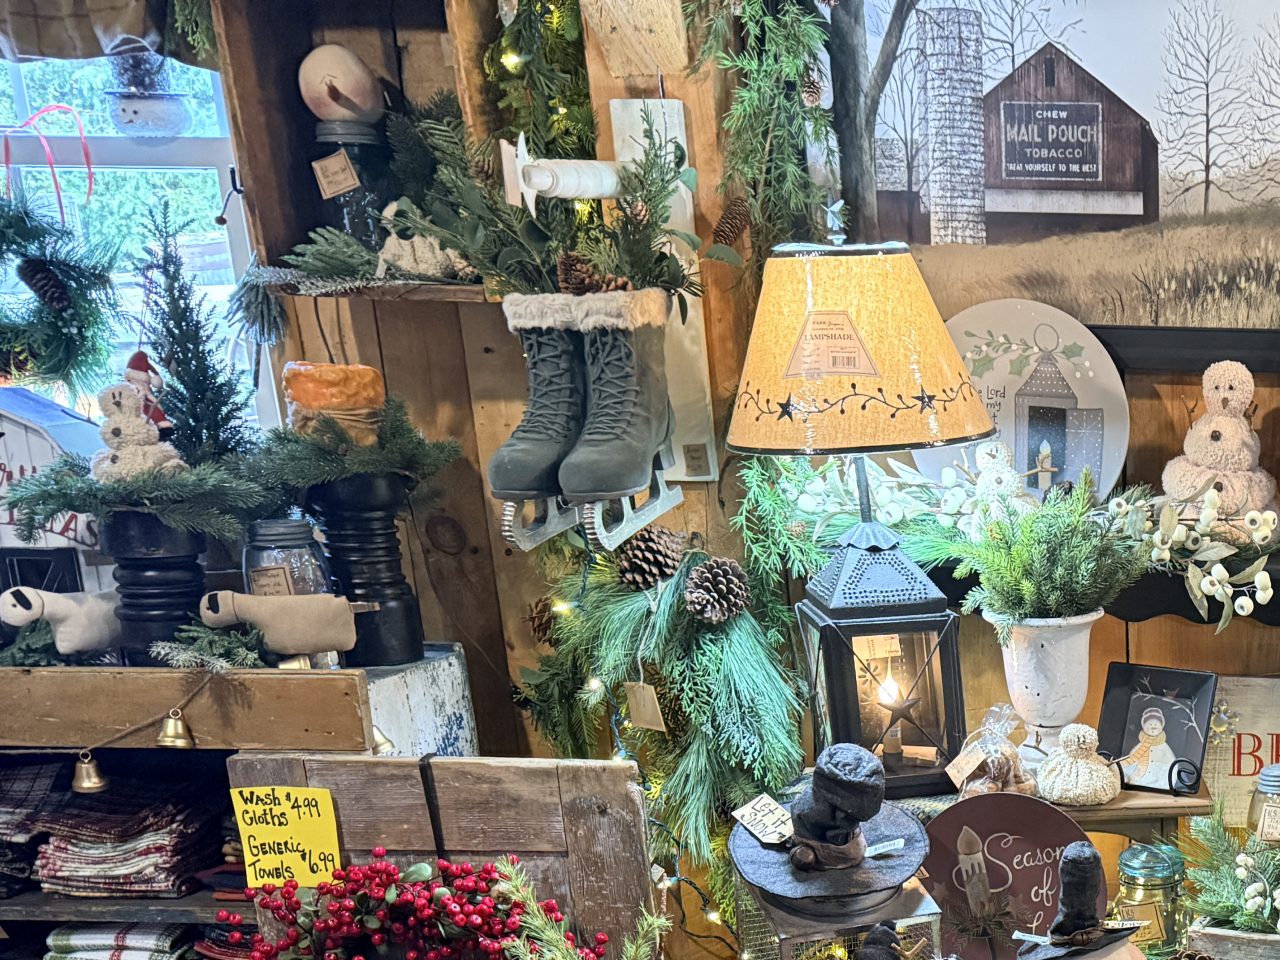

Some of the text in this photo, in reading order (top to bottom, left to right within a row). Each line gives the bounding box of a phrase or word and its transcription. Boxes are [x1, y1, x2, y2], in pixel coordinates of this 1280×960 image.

[1035, 110, 1068, 119] CHEW
[1006, 124, 1097, 143] MAIL POUCH
[1024, 148, 1083, 158] TOBACCO
[1007, 163, 1097, 173] TREAT YOURSELF TO THE BEST
[804, 333, 855, 341] LAMPSHADE
[986, 385, 1006, 400] Lord
[1031, 866, 1057, 907] of
